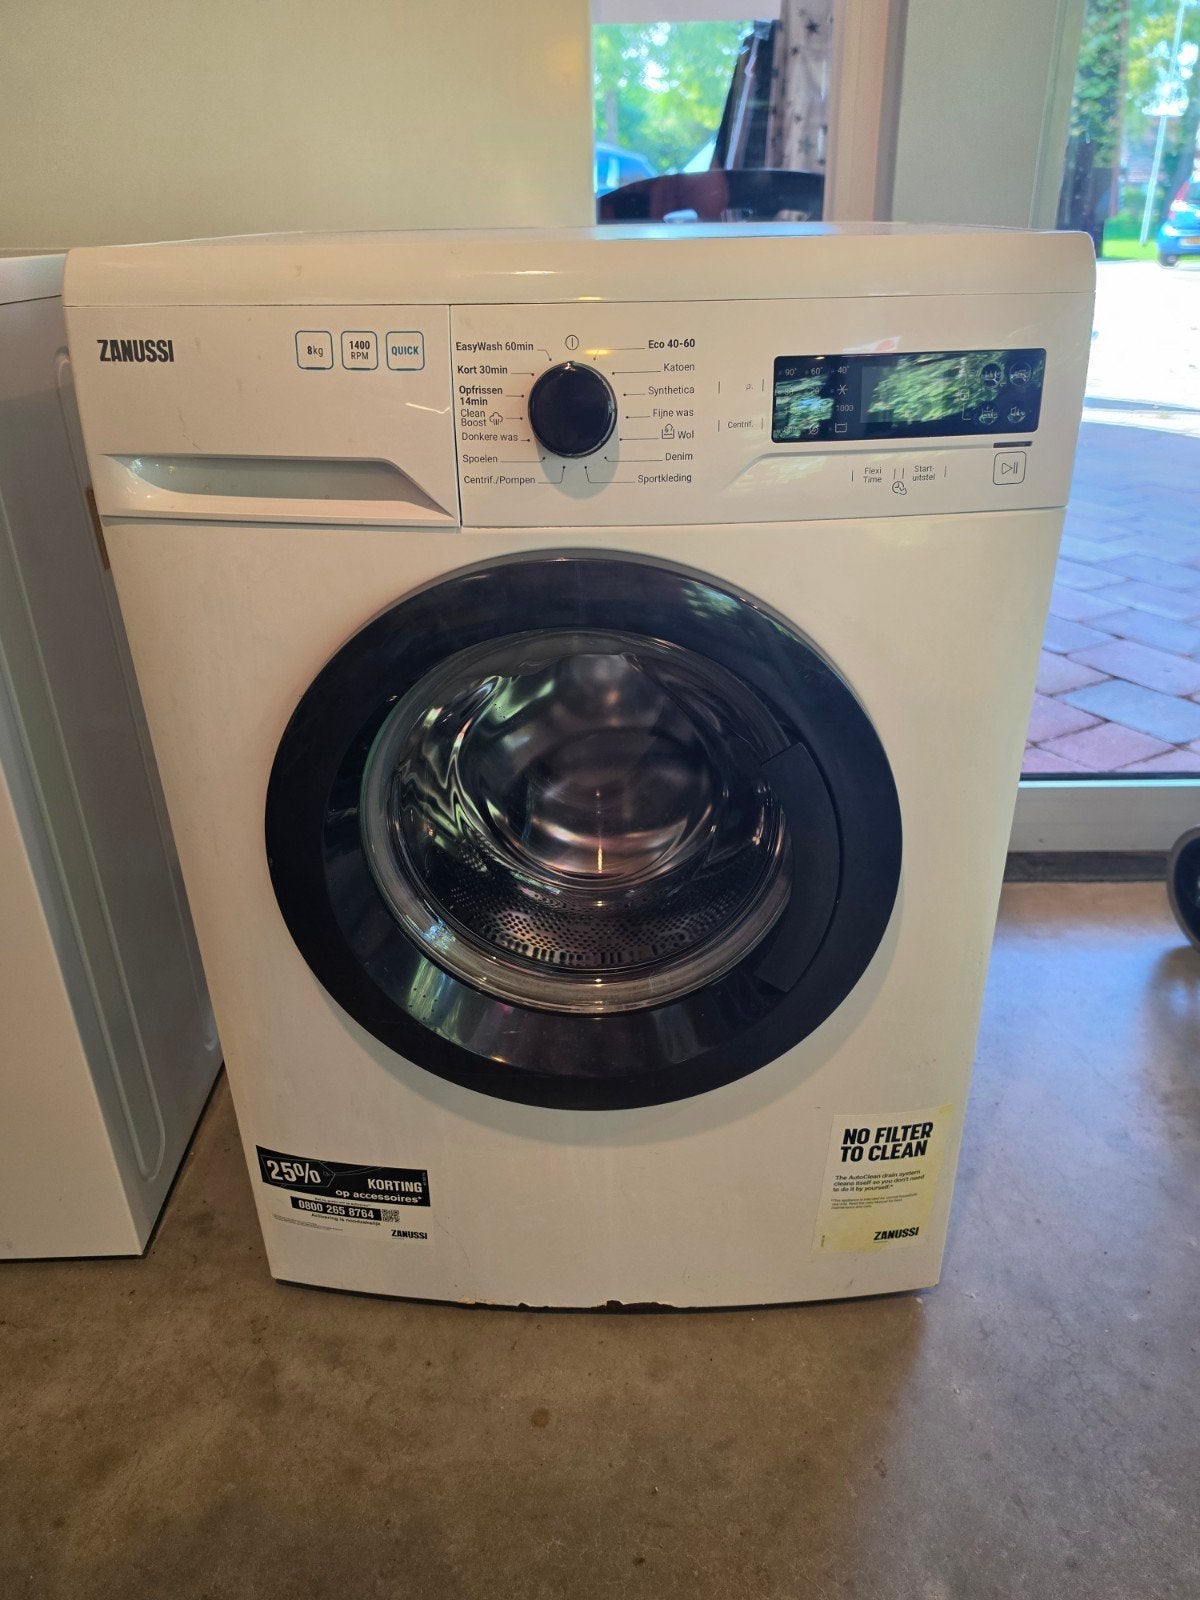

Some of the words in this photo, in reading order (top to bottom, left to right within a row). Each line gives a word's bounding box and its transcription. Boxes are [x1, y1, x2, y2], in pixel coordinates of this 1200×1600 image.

[349, 340, 370, 350] 1400
[456, 341, 503, 352] EasyWash
[505, 341, 534, 351] 60min
[648, 339, 665, 349] Eco
[667, 338, 696, 349] 40-60
[97, 339, 175, 363] ZANUSSI
[307, 345, 324, 358] 8kg
[350, 351, 369, 361] RPM
[391, 345, 419, 356] QUICK
[457, 365, 477, 375] Kort
[479, 365, 508, 375] 30min
[663, 362, 696, 372] Katoen
[459, 385, 503, 397] Opfrissen
[648, 385, 695, 397] Synthetica
[460, 397, 488, 406] 14min
[460, 408, 486, 418] Clean
[653, 408, 674, 419] Fijne
[675, 409, 694, 417] was
[461, 417, 487, 427] Boost
[727, 419, 754, 429] Centrif.
[462, 432, 498, 442] Donkere
[500, 434, 519, 442] was
[677, 430, 695, 439] Wol
[462, 454, 498, 465] Spoelen
[665, 451, 693, 461] Denim
[864, 466, 882, 475] Flexi
[914, 464, 935, 473] Start-
[463, 475, 536, 486] Centrif./Pompen
[637, 473, 692, 485] Sportkleding
[912, 473, 936, 482] uitstel
[842, 1126, 871, 1145] NO
[874, 1121, 934, 1144] FILTER
[840, 1145, 864, 1162] TO
[868, 1139, 929, 1161] CLEAN
[266, 1159, 322, 1184] 25%
[367, 1178, 423, 1194] KORTING
[335, 1189, 350, 1198] op
[298, 1200, 323, 1213] 0800
[326, 1203, 346, 1216] 265
[348, 1207, 374, 1219] 8764
[391, 1229, 428, 1240] ZANUSSI
[873, 1226, 920, 1241] ZANUSSI
